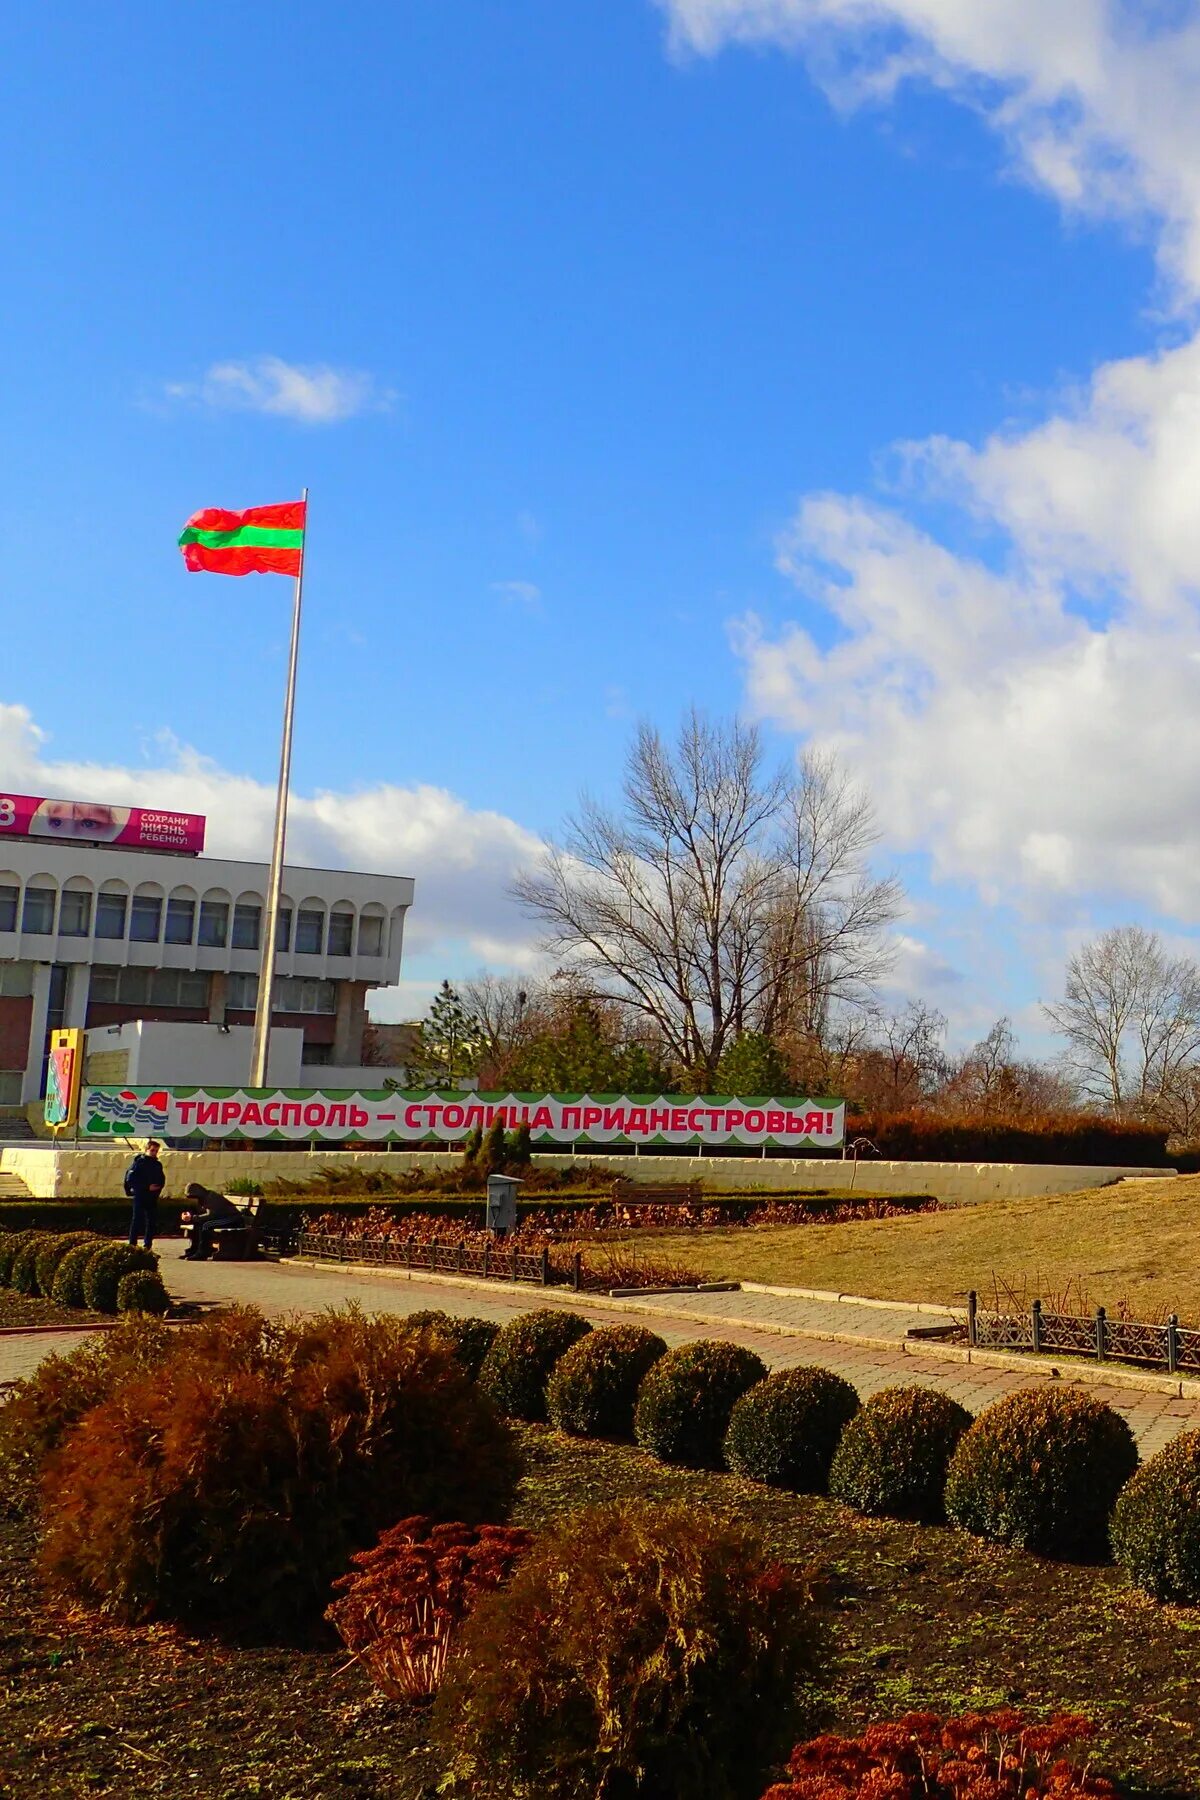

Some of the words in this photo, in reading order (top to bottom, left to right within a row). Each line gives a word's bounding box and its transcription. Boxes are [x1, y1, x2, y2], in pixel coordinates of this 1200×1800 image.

[141, 813, 189, 826] СОХРАНИ
[140, 822, 186, 836] ЖИЗНЬ
[140, 832, 188, 845] РЕБЕНКУ!
[175, 1101, 369, 1128] ТИРАСПОЛЬ
[404, 1104, 555, 1129] СТОЛИЦА
[561, 1106, 834, 1135] ПРИДНЕСТРОВЬЯ!
